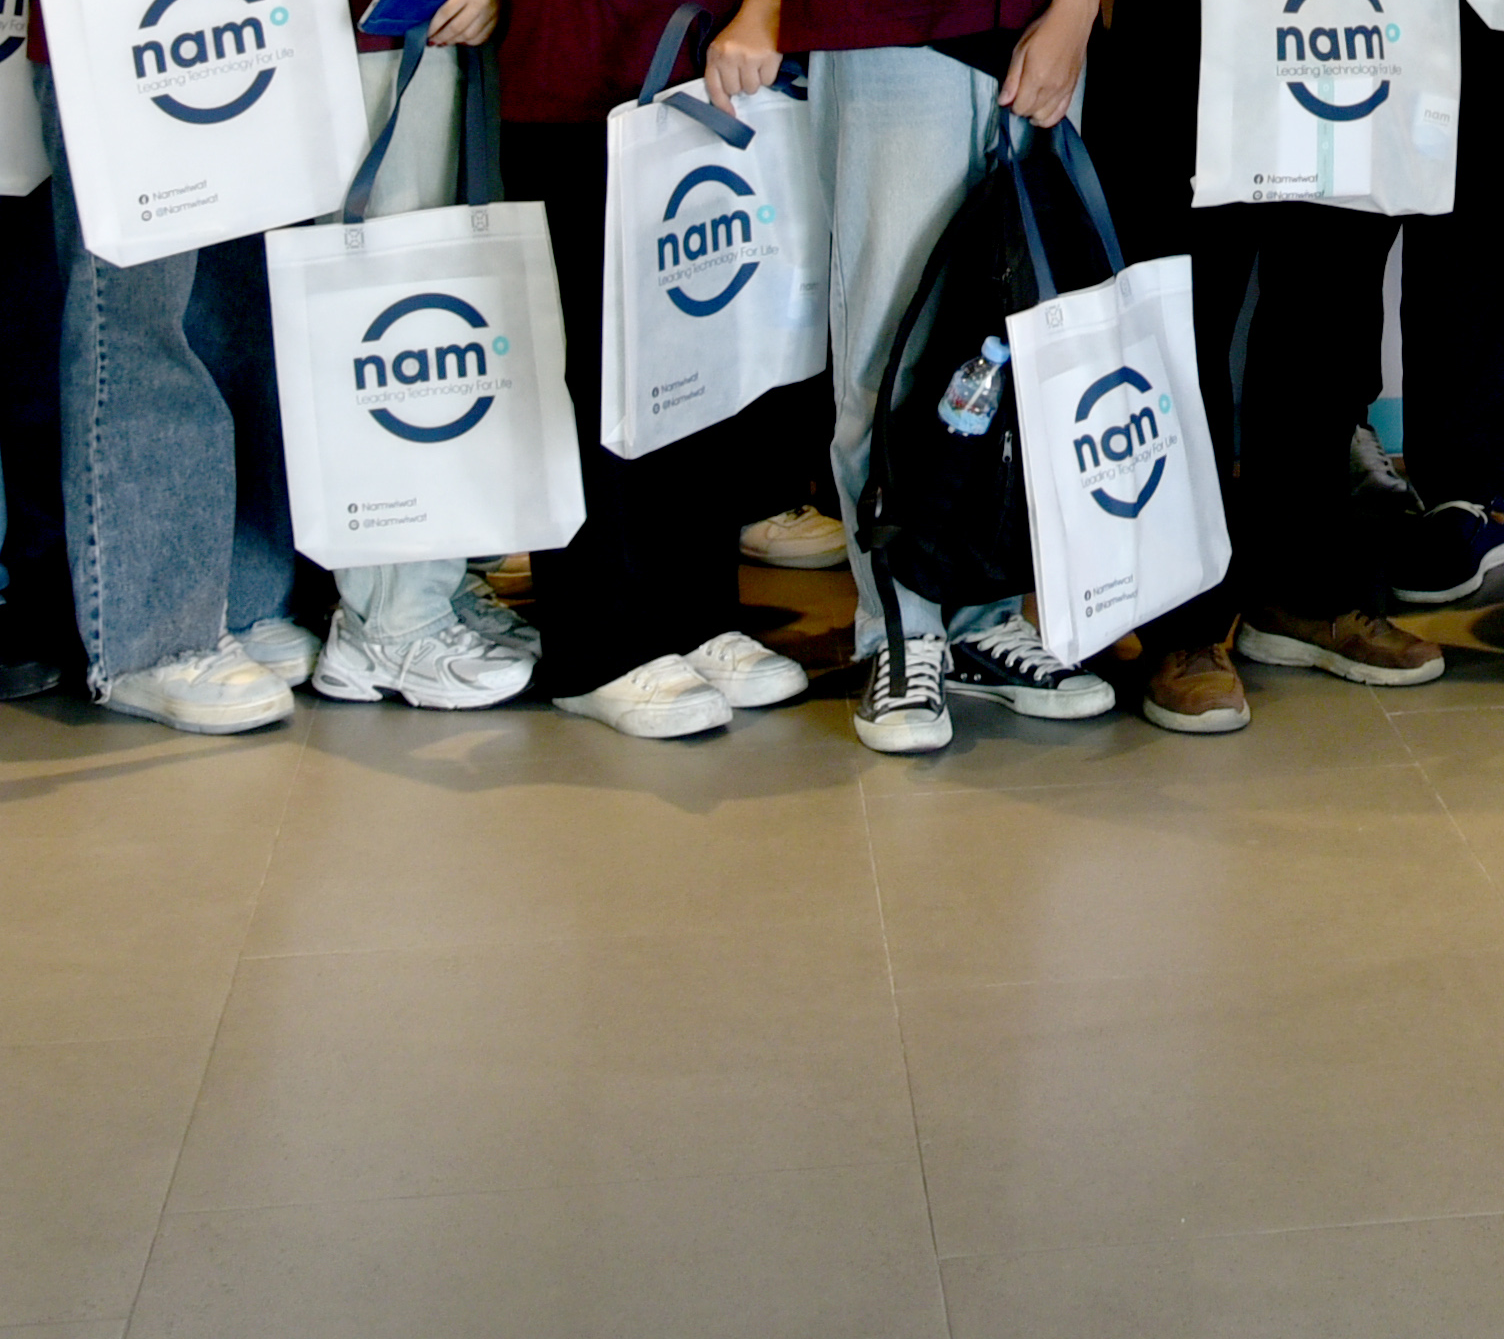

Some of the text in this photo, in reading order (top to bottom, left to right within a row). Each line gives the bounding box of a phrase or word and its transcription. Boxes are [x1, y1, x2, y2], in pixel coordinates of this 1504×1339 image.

[137, 47, 295, 94] Leading Technology For Life
